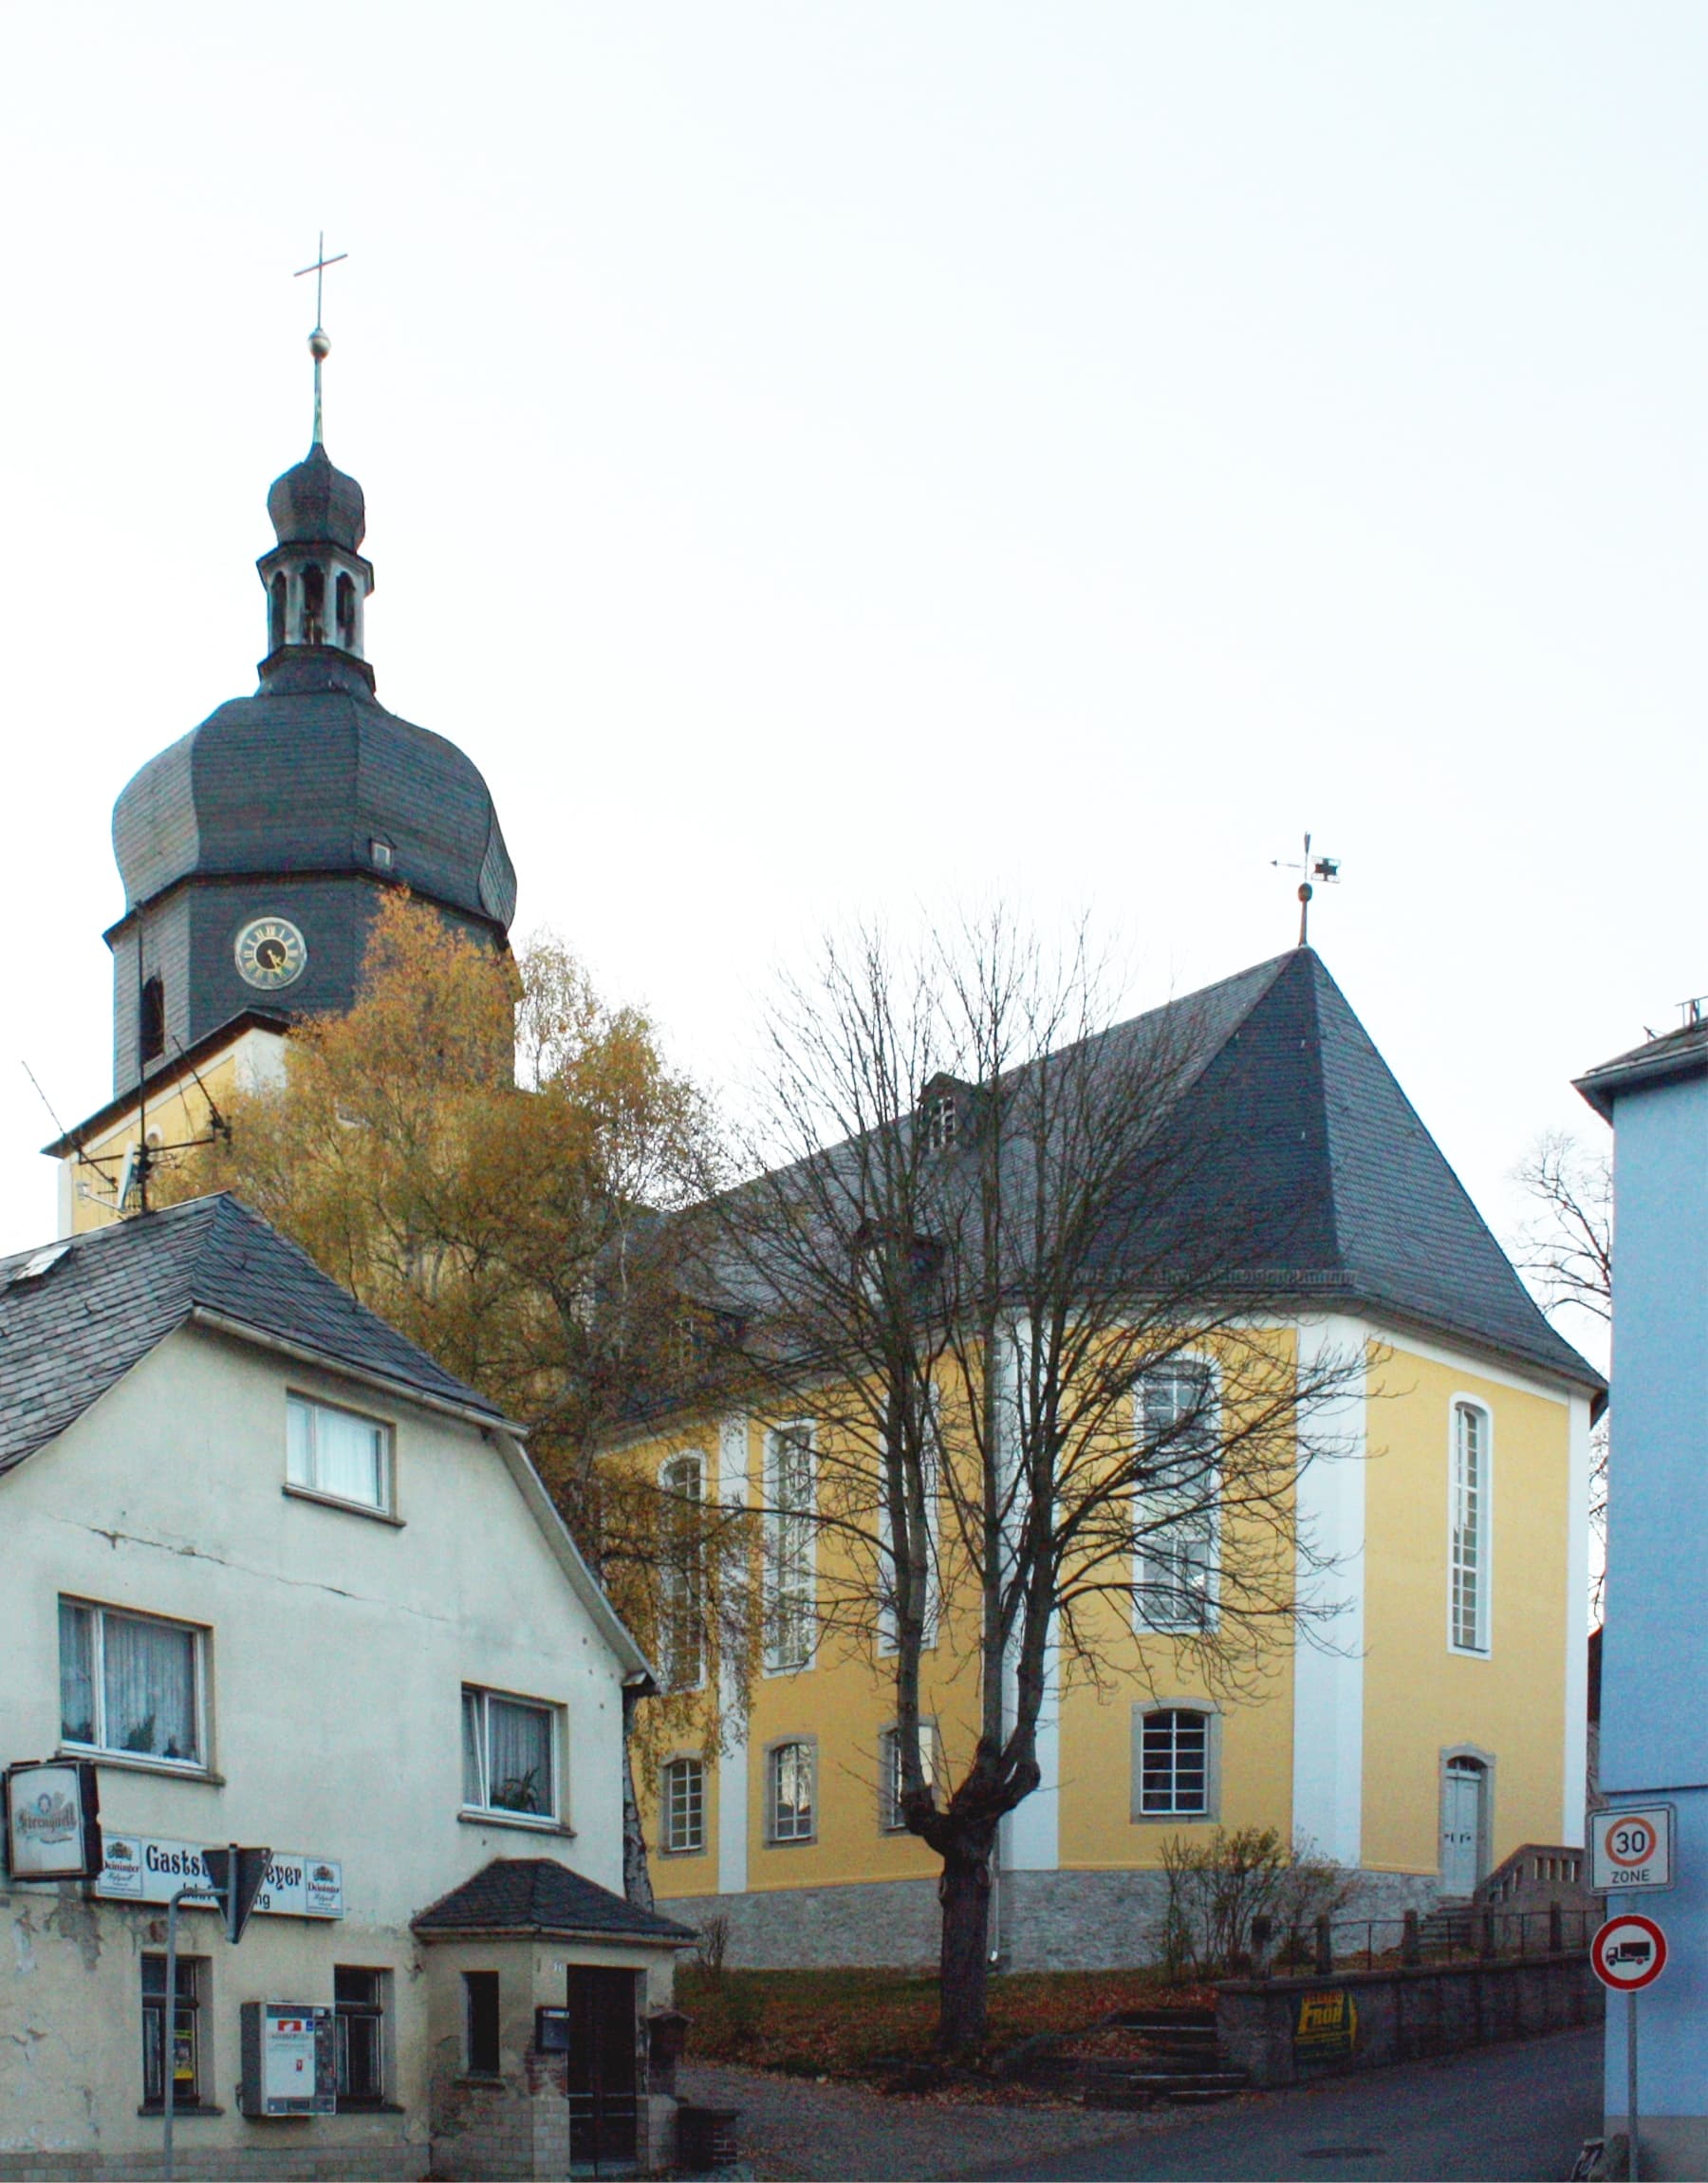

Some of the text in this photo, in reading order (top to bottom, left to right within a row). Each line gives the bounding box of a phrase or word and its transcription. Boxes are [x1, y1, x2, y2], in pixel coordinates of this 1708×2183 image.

[1616, 1830, 1645, 1854] 30
[266, 1864, 302, 1891] eyer
[1611, 1868, 1651, 1884] ZONE
